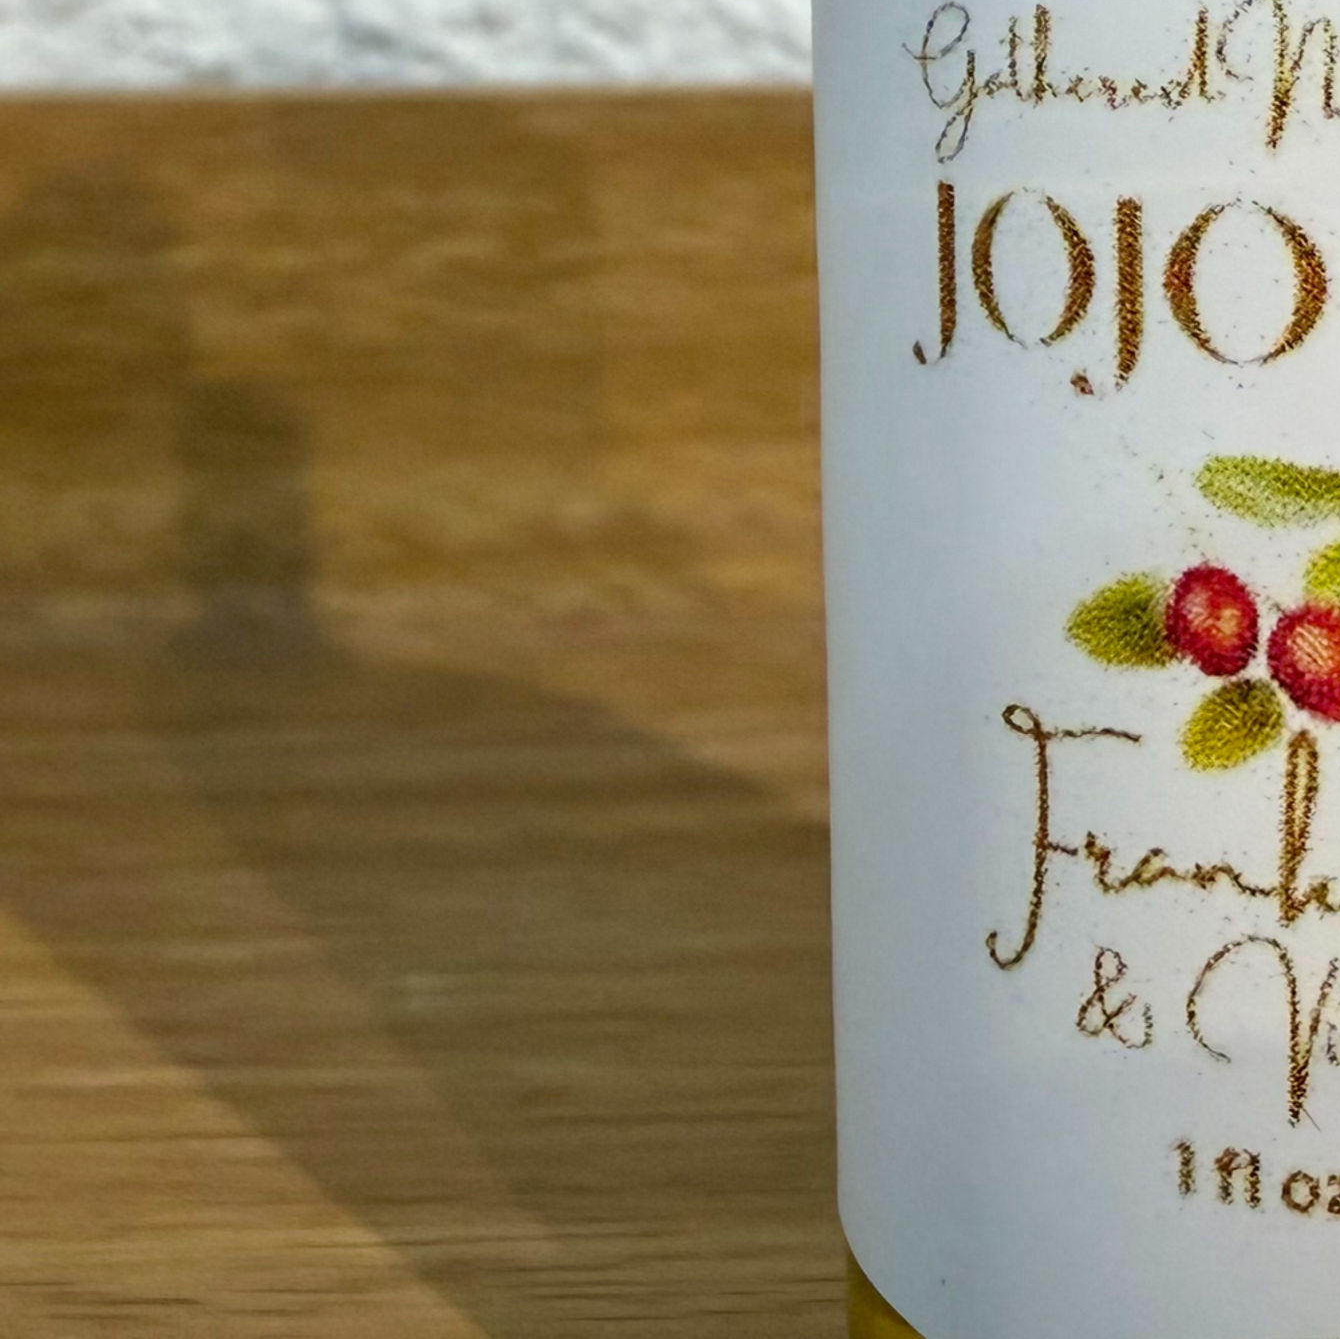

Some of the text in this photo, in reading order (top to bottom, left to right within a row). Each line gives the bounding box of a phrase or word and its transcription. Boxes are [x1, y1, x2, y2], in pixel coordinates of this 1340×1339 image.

[1075, 946, 1155, 1051] &
[1172, 1139, 1196, 1197] 1
[1214, 1146, 1262, 1210] fl
